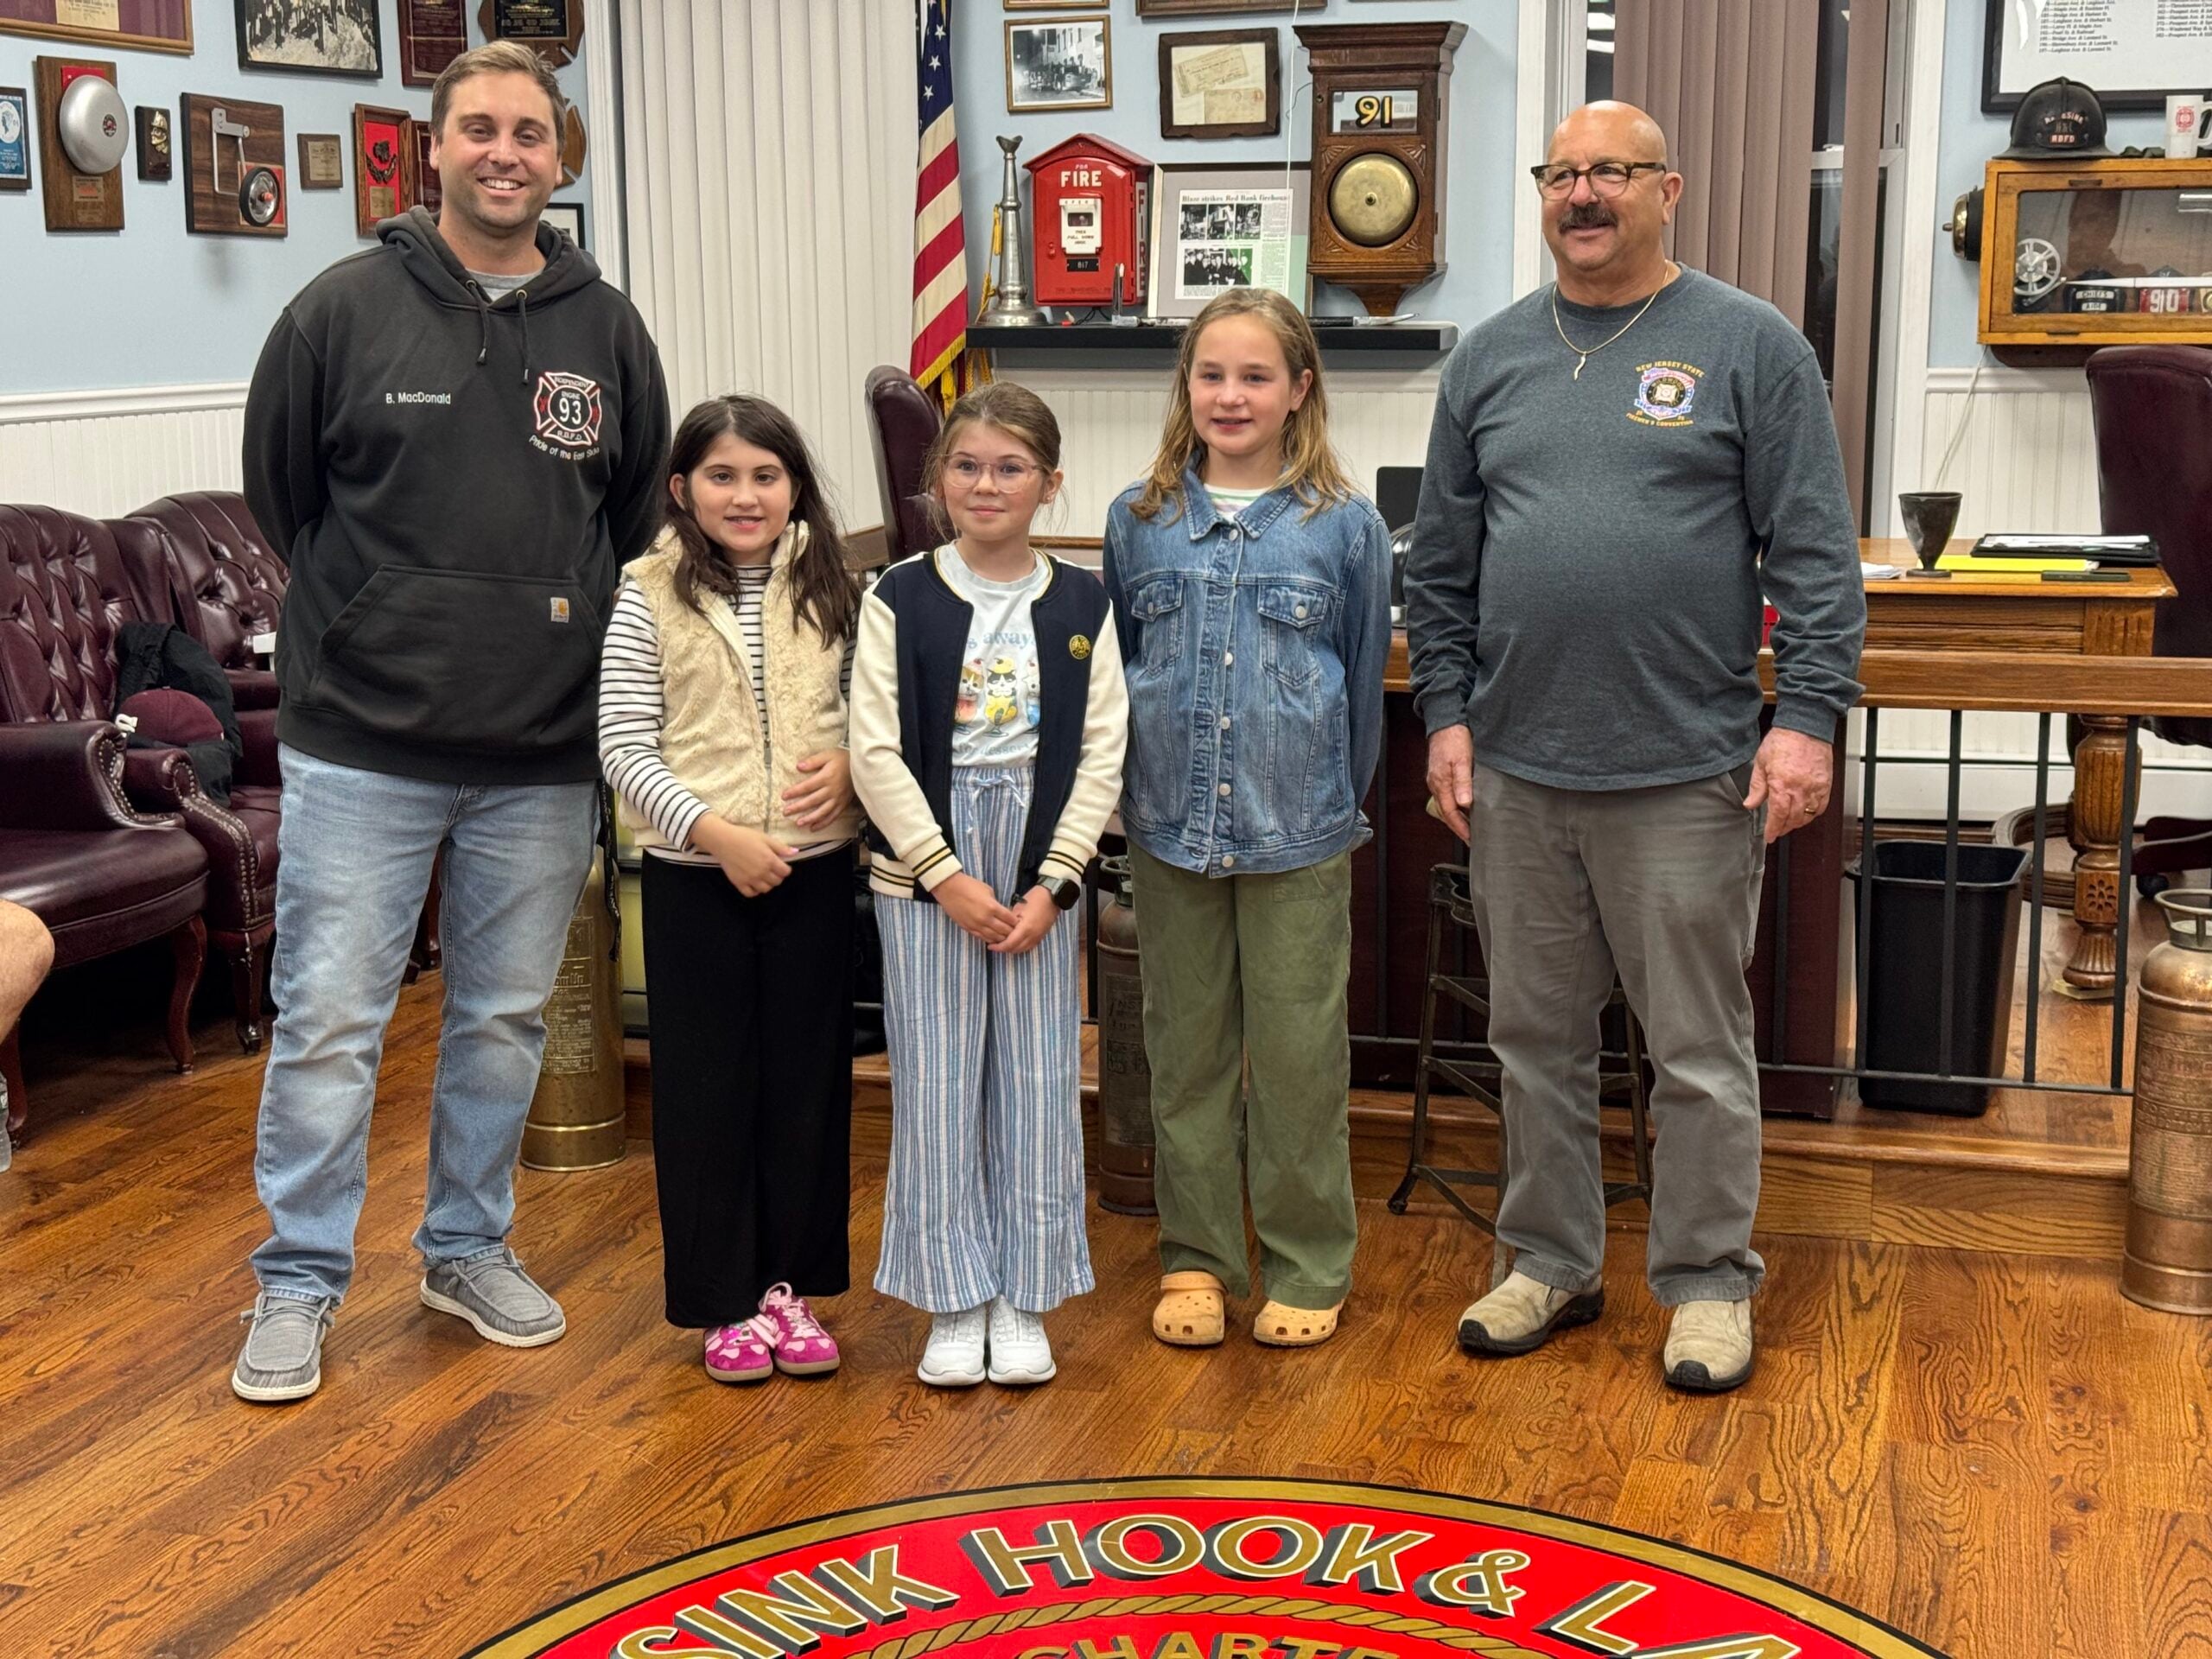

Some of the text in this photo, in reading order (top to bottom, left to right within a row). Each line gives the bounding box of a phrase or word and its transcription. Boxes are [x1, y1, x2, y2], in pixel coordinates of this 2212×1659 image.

[1355, 96, 1392, 128] 91
[1060, 170, 1103, 188] FIRE
[1138, 188, 1147, 291] FIRE
[1682, 363, 1706, 378] STATE
[385, 391, 451, 404] B. MacDonald
[561, 391, 581, 399] ENGINE
[559, 397, 582, 425] 93
[529, 435, 548, 451] Pride
[549, 446, 559, 456] of
[560, 449, 571, 460] the
[969, 1514, 1434, 1592] HOOK
[1429, 1549, 1530, 1617] &
